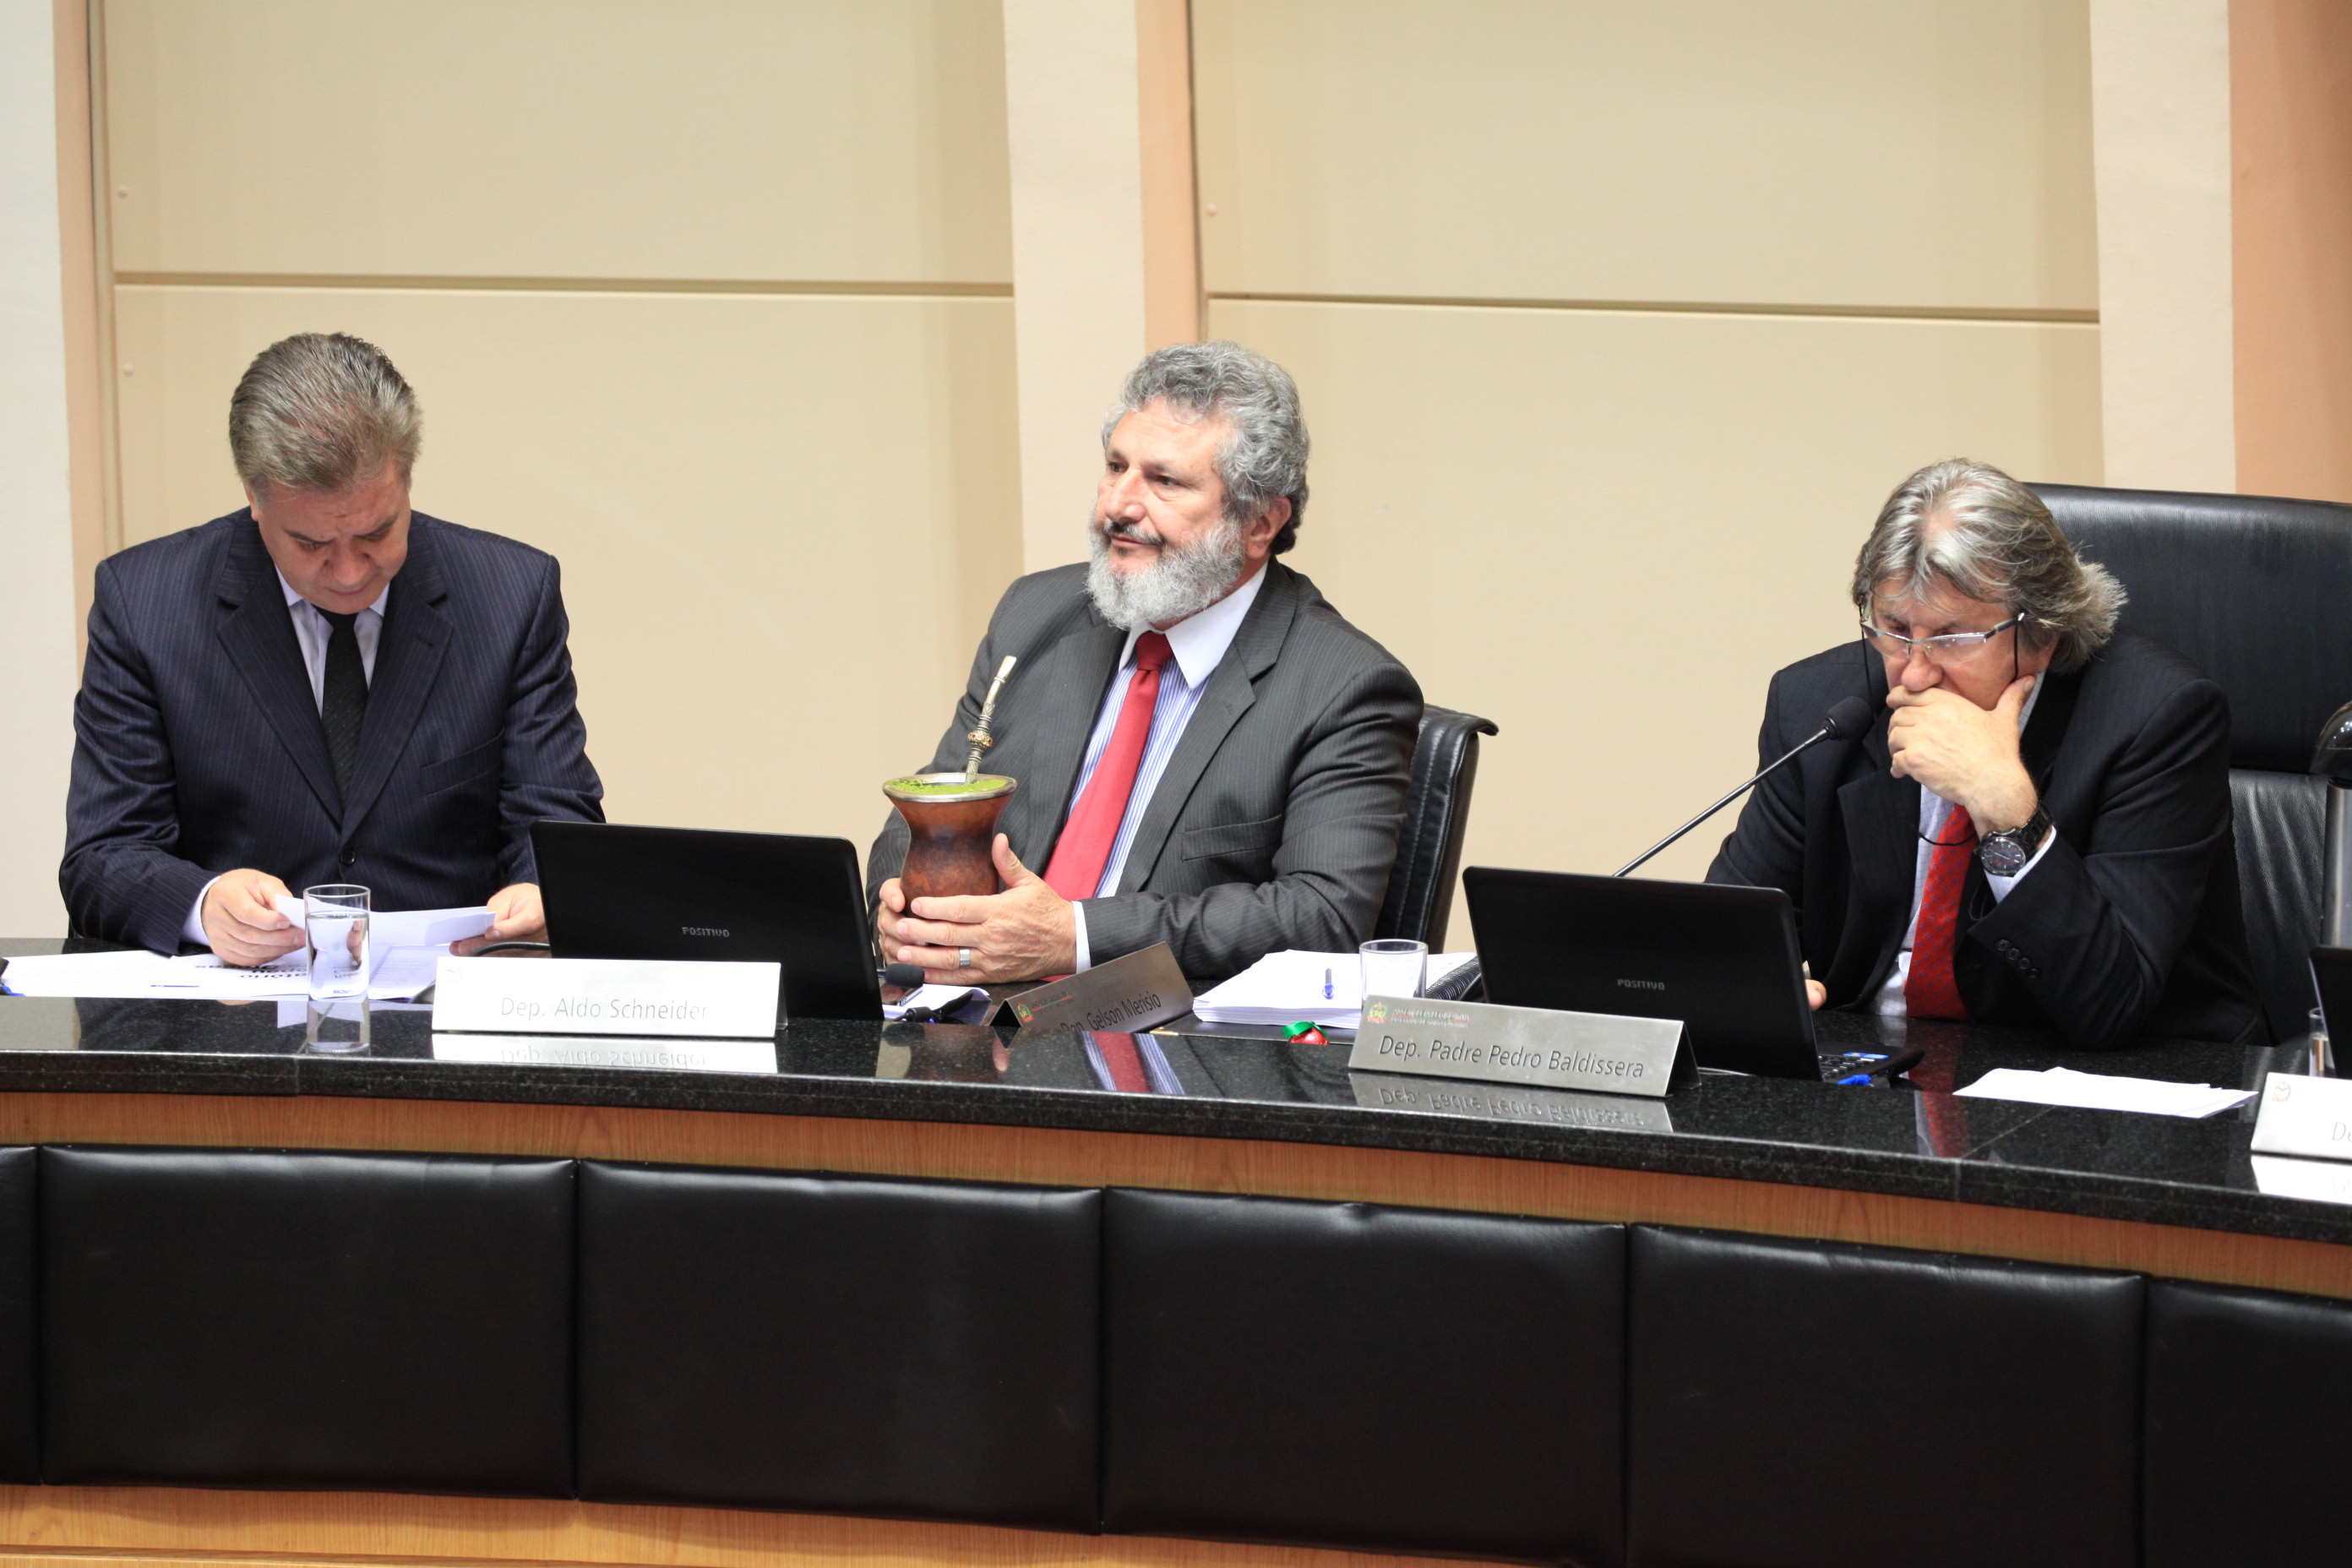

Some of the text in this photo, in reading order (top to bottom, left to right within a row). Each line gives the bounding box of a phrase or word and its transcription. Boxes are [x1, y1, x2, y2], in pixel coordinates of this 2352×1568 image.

[682, 926, 730, 938] POSITIVO
[501, 996, 709, 1021] Dep. Aldo Schneider
[1086, 1006, 1124, 1032] Gelson
[1121, 990, 1162, 1021] Merisio
[1379, 1035, 1645, 1078] Dep. Padre Pedro Baldissera
